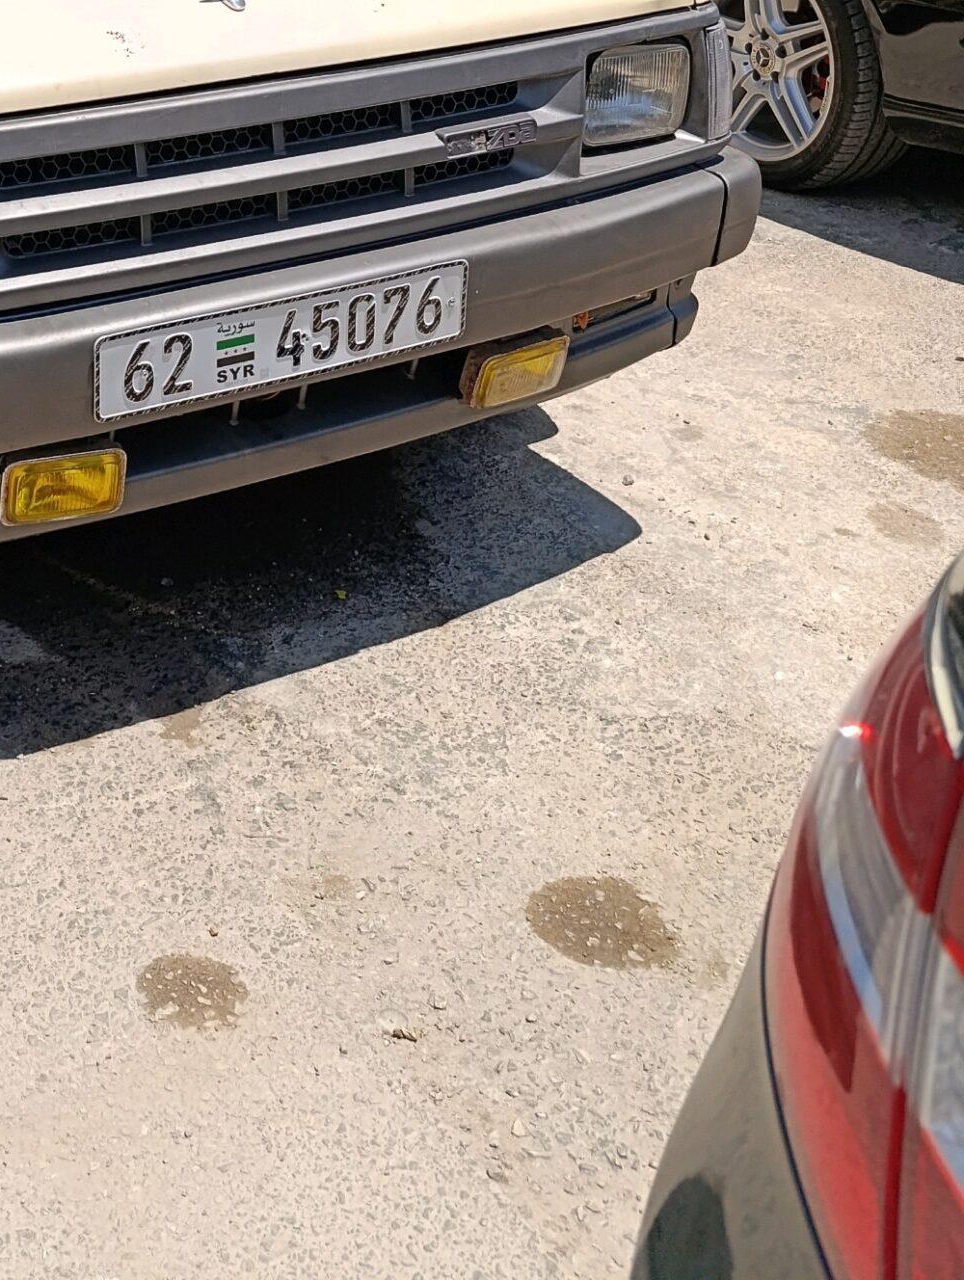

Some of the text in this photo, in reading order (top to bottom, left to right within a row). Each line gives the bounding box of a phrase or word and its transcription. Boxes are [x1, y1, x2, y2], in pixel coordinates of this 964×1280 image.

[216, 320, 256, 335] سورية
[275, 275, 443, 367] 45076
[123, 332, 194, 403] 62
[216, 363, 255, 383] SYR
